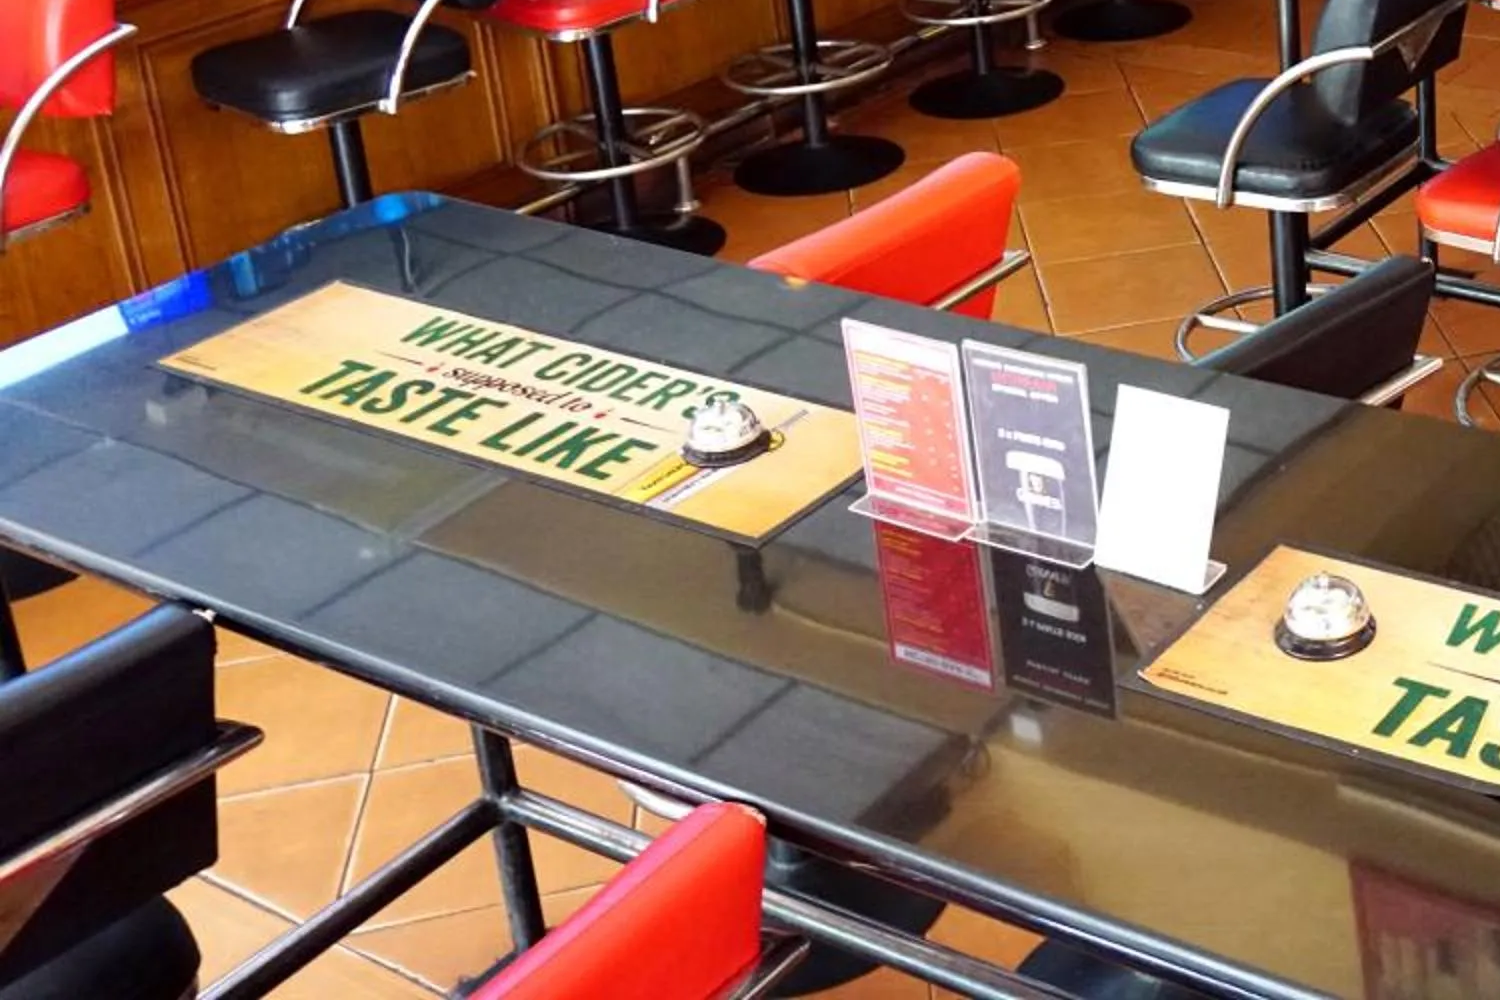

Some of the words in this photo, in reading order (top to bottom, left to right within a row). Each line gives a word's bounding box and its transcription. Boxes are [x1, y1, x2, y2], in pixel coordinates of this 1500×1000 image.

[400, 316, 554, 369] WHAT
[442, 368, 571, 405] supposed
[559, 396, 593, 413] to
[299, 360, 510, 436] TASTE
[479, 412, 660, 480] LIKE
